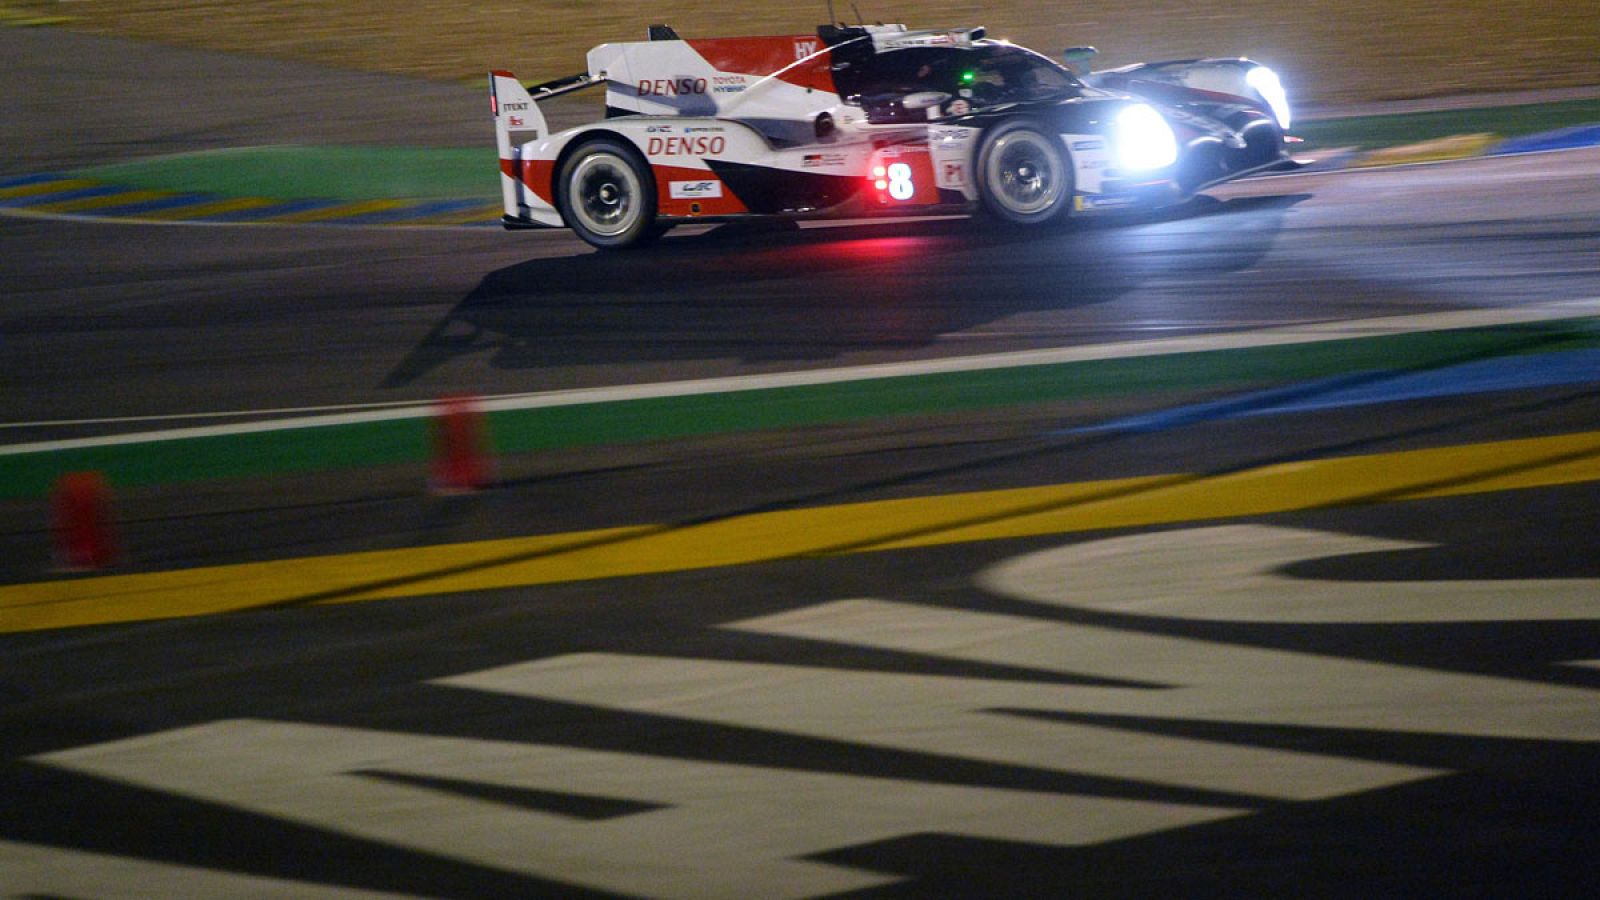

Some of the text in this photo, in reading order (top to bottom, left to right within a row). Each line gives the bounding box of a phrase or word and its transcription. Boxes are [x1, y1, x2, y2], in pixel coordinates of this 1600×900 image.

[638, 77, 707, 96] DENSO
[647, 136, 726, 156] DENSO
[887, 162, 915, 201] 8
